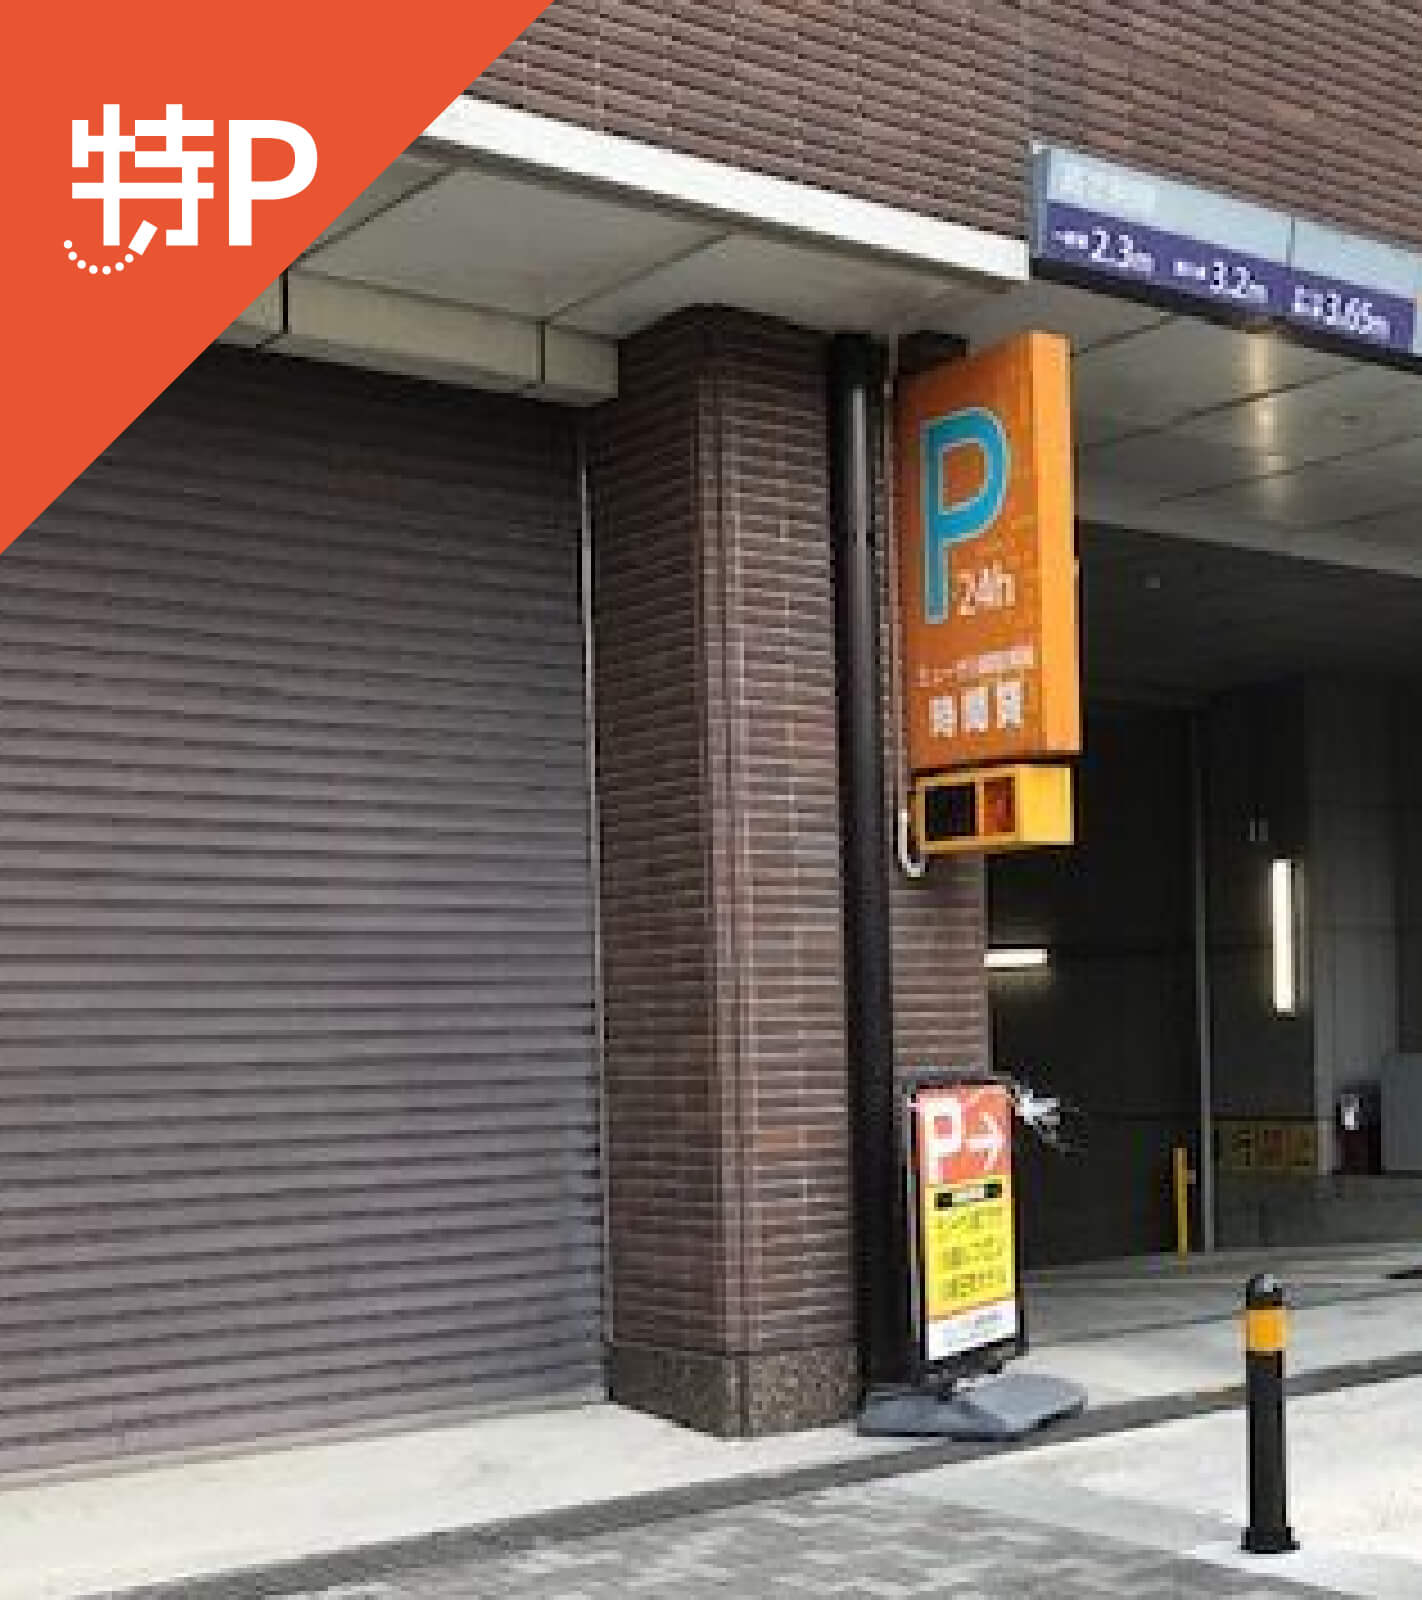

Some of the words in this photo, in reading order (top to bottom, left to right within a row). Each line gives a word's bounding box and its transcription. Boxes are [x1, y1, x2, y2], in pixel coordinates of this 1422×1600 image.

[920, 407, 1010, 625] P
[957, 560, 1016, 616] 24h
[922, 1097, 962, 1184] P
